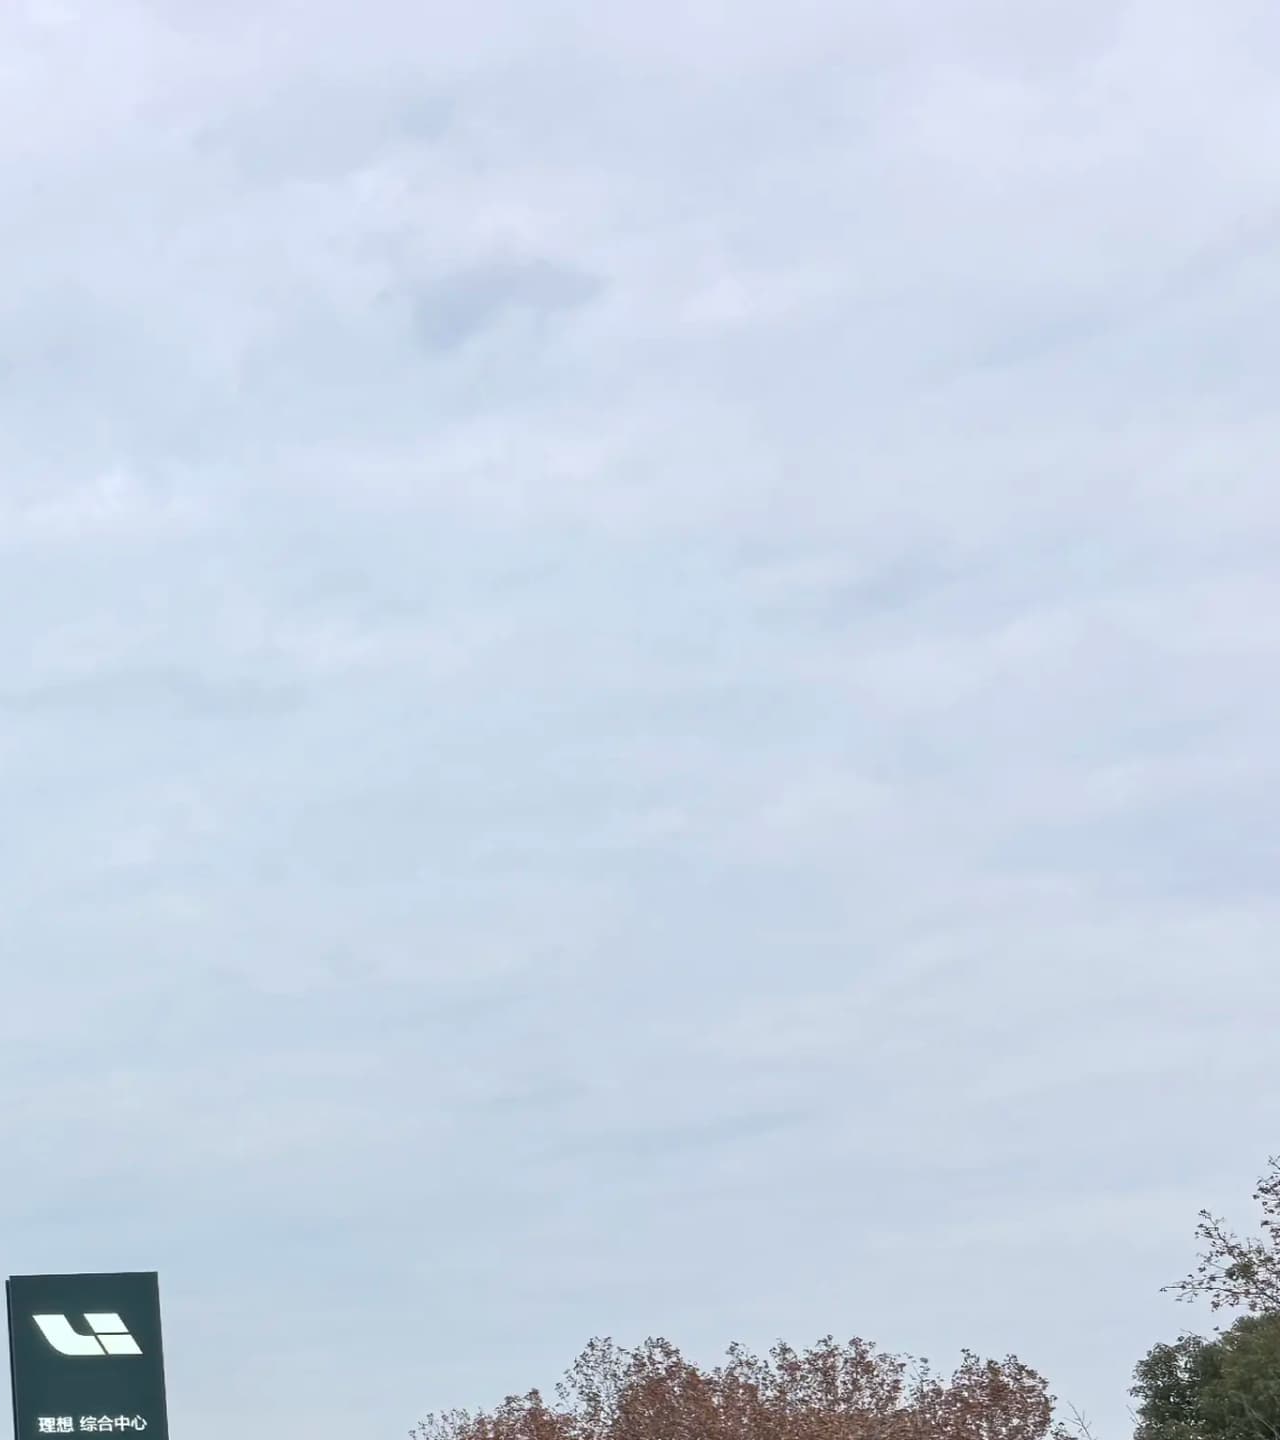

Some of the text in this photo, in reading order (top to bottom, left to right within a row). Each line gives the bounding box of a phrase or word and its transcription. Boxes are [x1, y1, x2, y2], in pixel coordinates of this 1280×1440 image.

[37, 1414, 148, 1433] 理想 综合中心
